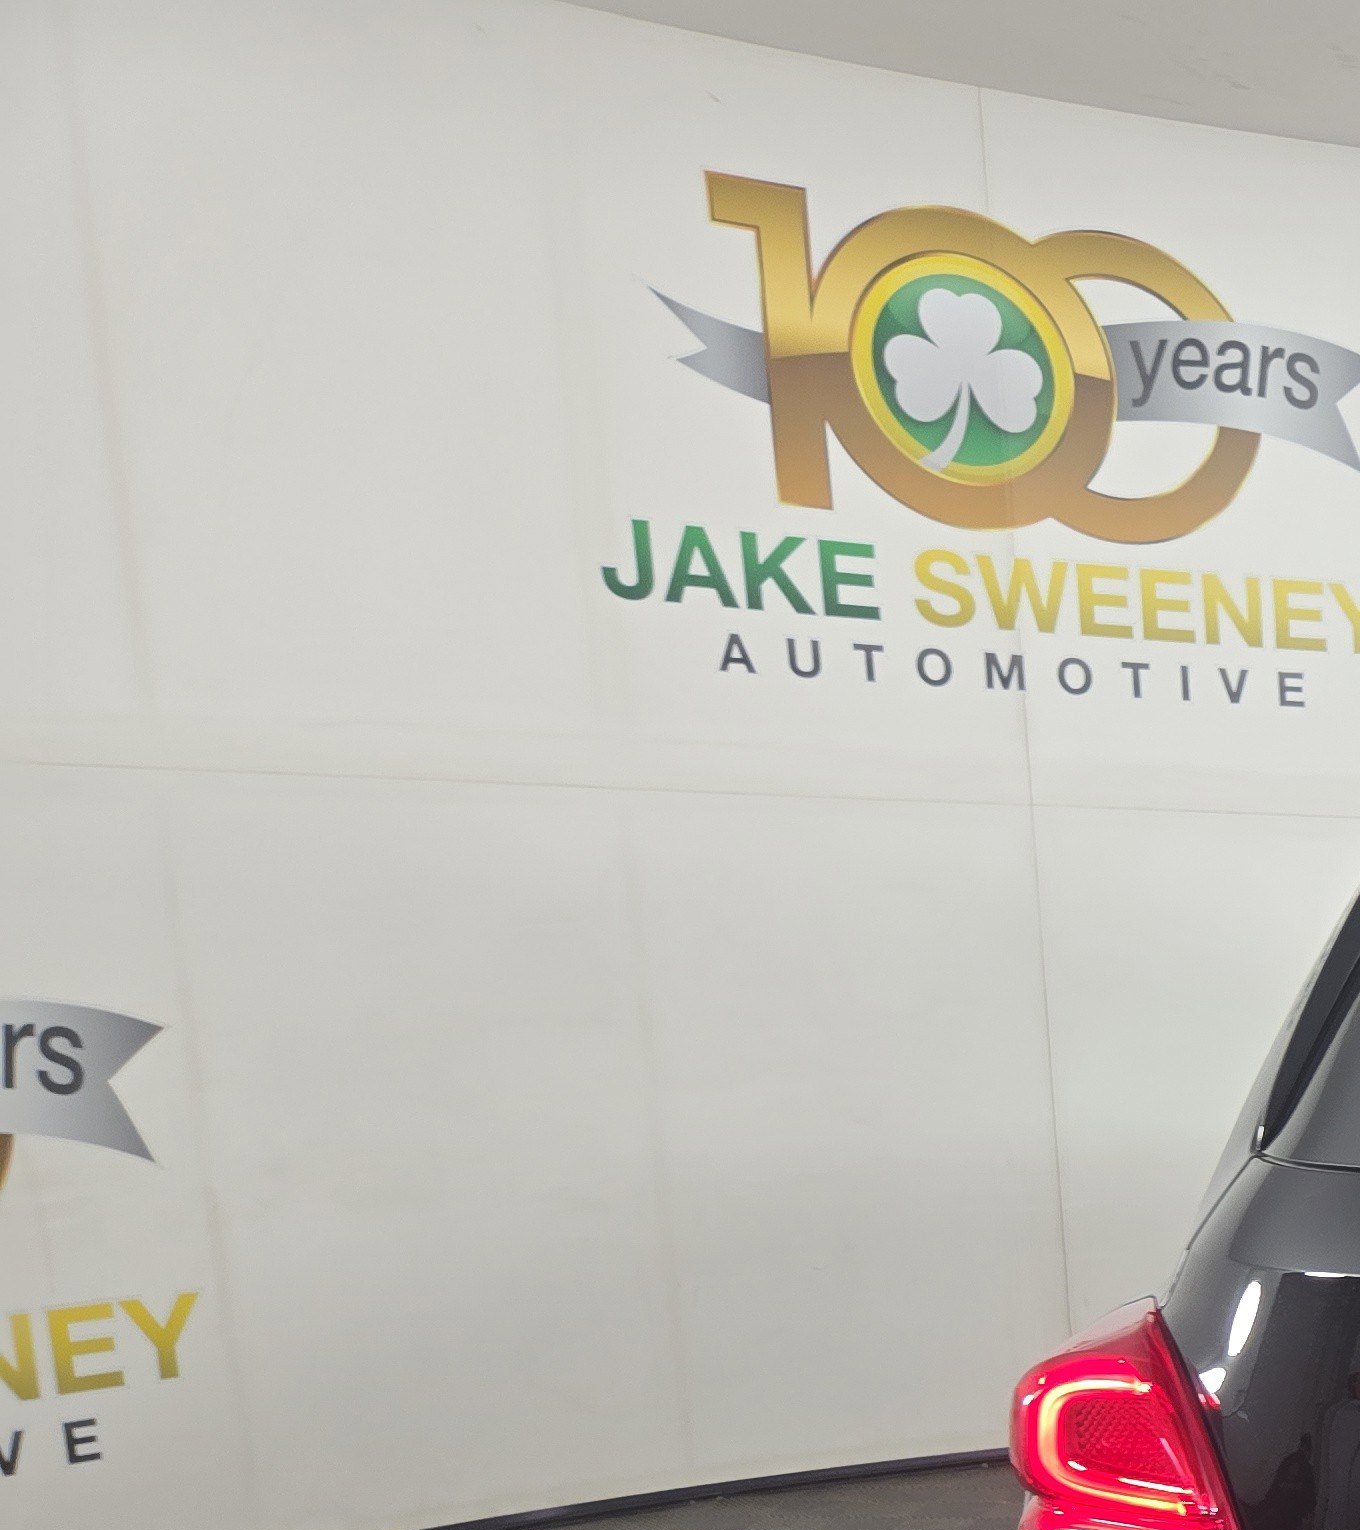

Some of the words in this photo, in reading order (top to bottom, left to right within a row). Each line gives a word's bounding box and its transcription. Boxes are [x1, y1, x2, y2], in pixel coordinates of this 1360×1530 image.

[703, 169, 1261, 544] 100
[1128, 336, 1321, 409] years
[601, 519, 881, 621] JAKE
[719, 633, 1306, 708] AUTOMOTIVE
